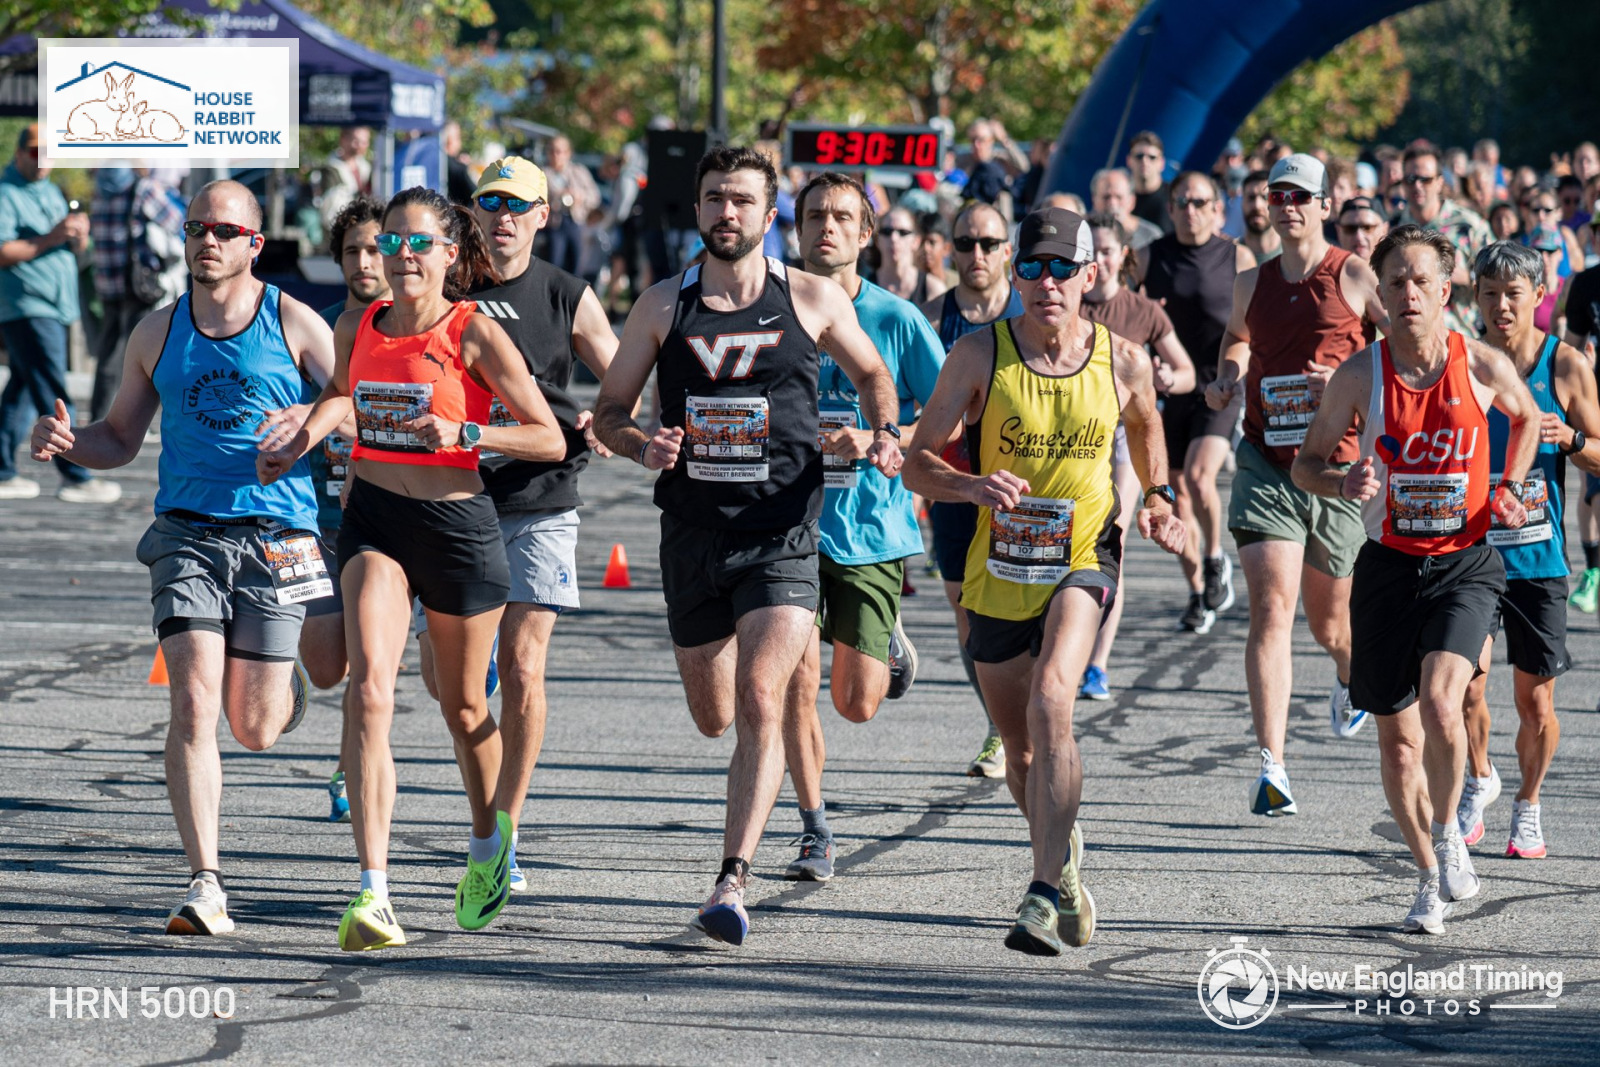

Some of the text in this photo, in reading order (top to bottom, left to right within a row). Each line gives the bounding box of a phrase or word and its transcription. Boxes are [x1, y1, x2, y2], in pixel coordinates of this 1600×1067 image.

[685, 330, 784, 381] VT
[188, 369, 256, 407] CENTRAL MASS
[195, 409, 253, 430] STRIDERS
[999, 416, 1105, 455] Somerville
[1014, 447, 1096, 459] ROAD RUNNERS
[1402, 426, 1478, 464] CSU
[997, 569, 1028, 579] WACHUSETT
